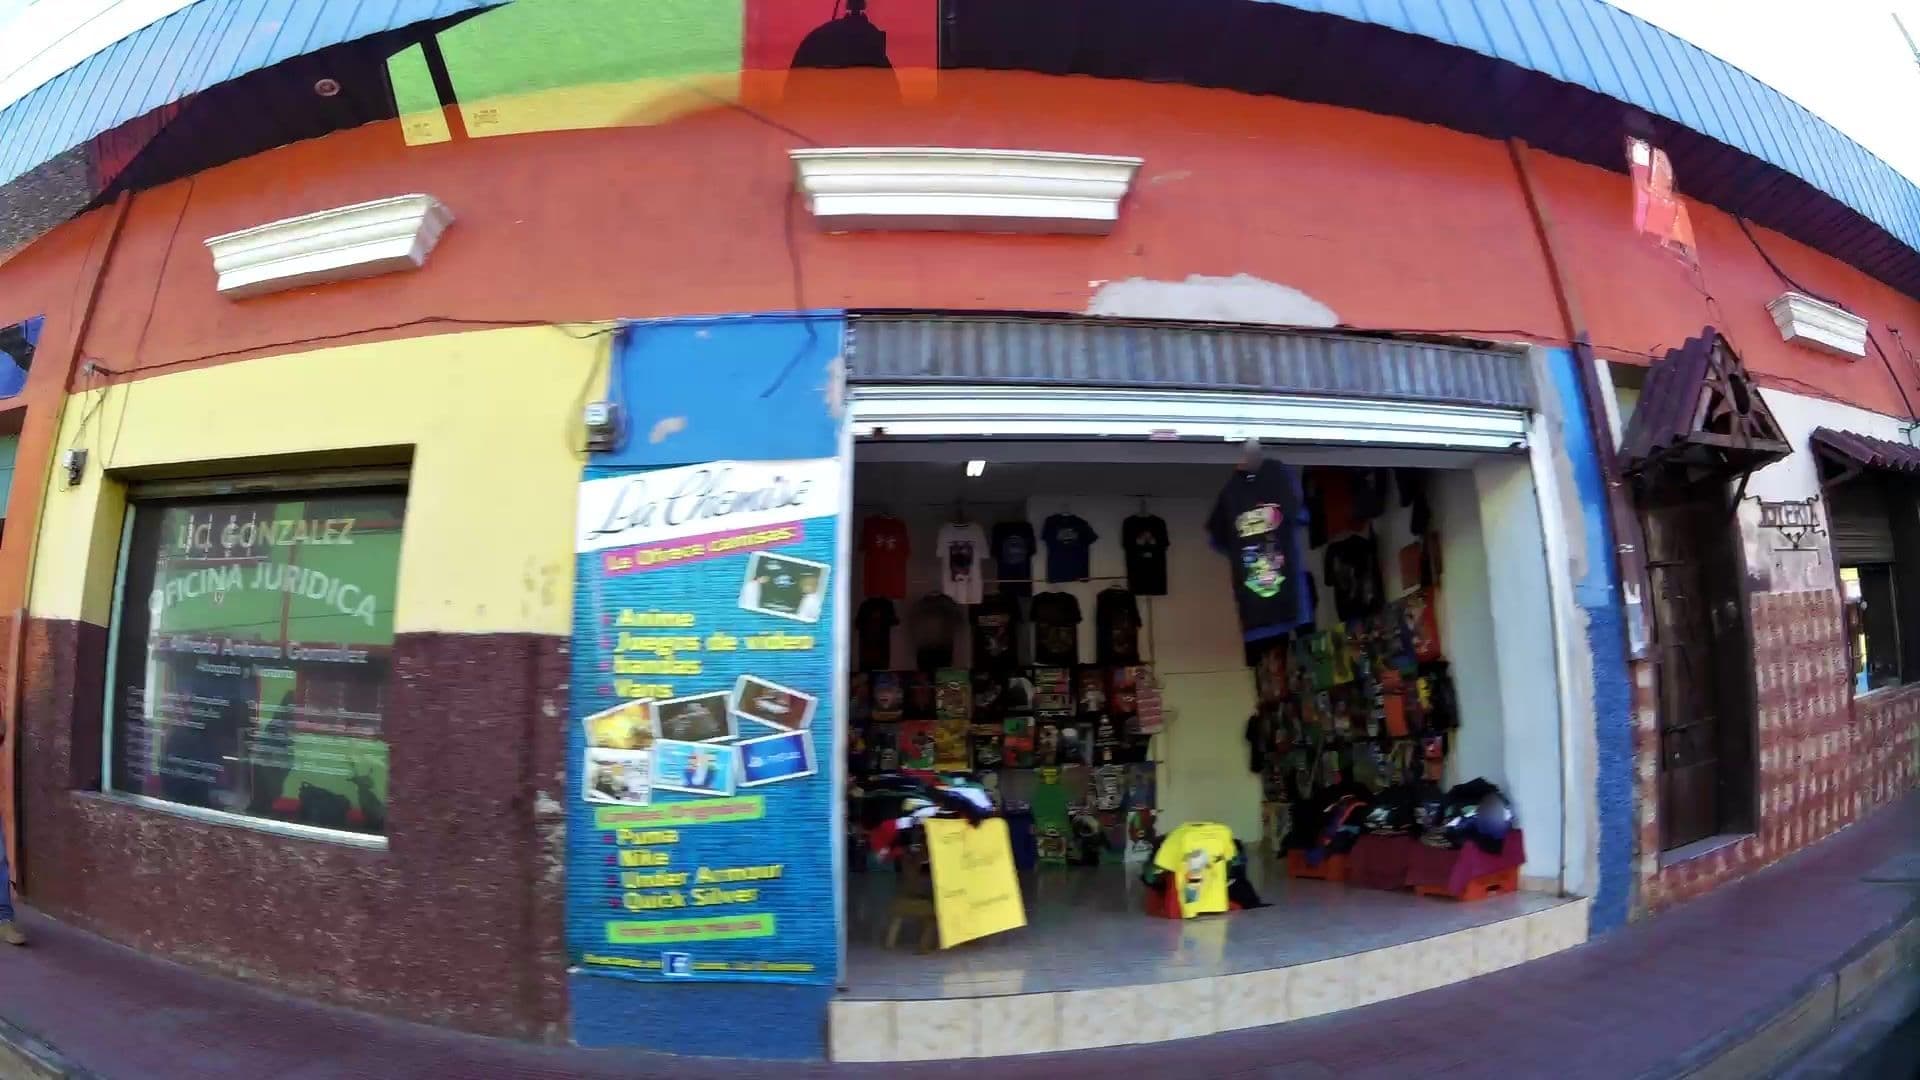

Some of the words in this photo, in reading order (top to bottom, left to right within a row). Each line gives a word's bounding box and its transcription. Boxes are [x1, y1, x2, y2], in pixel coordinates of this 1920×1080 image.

[220, 518, 356, 549] GONZALEZ
[148, 563, 243, 613] OFICINA
[251, 561, 377, 627] JURIDICA
[621, 870, 688, 889] Under
[696, 864, 784, 884] Armour
[622, 891, 687, 912] Quick
[691, 887, 761, 906] Silver
